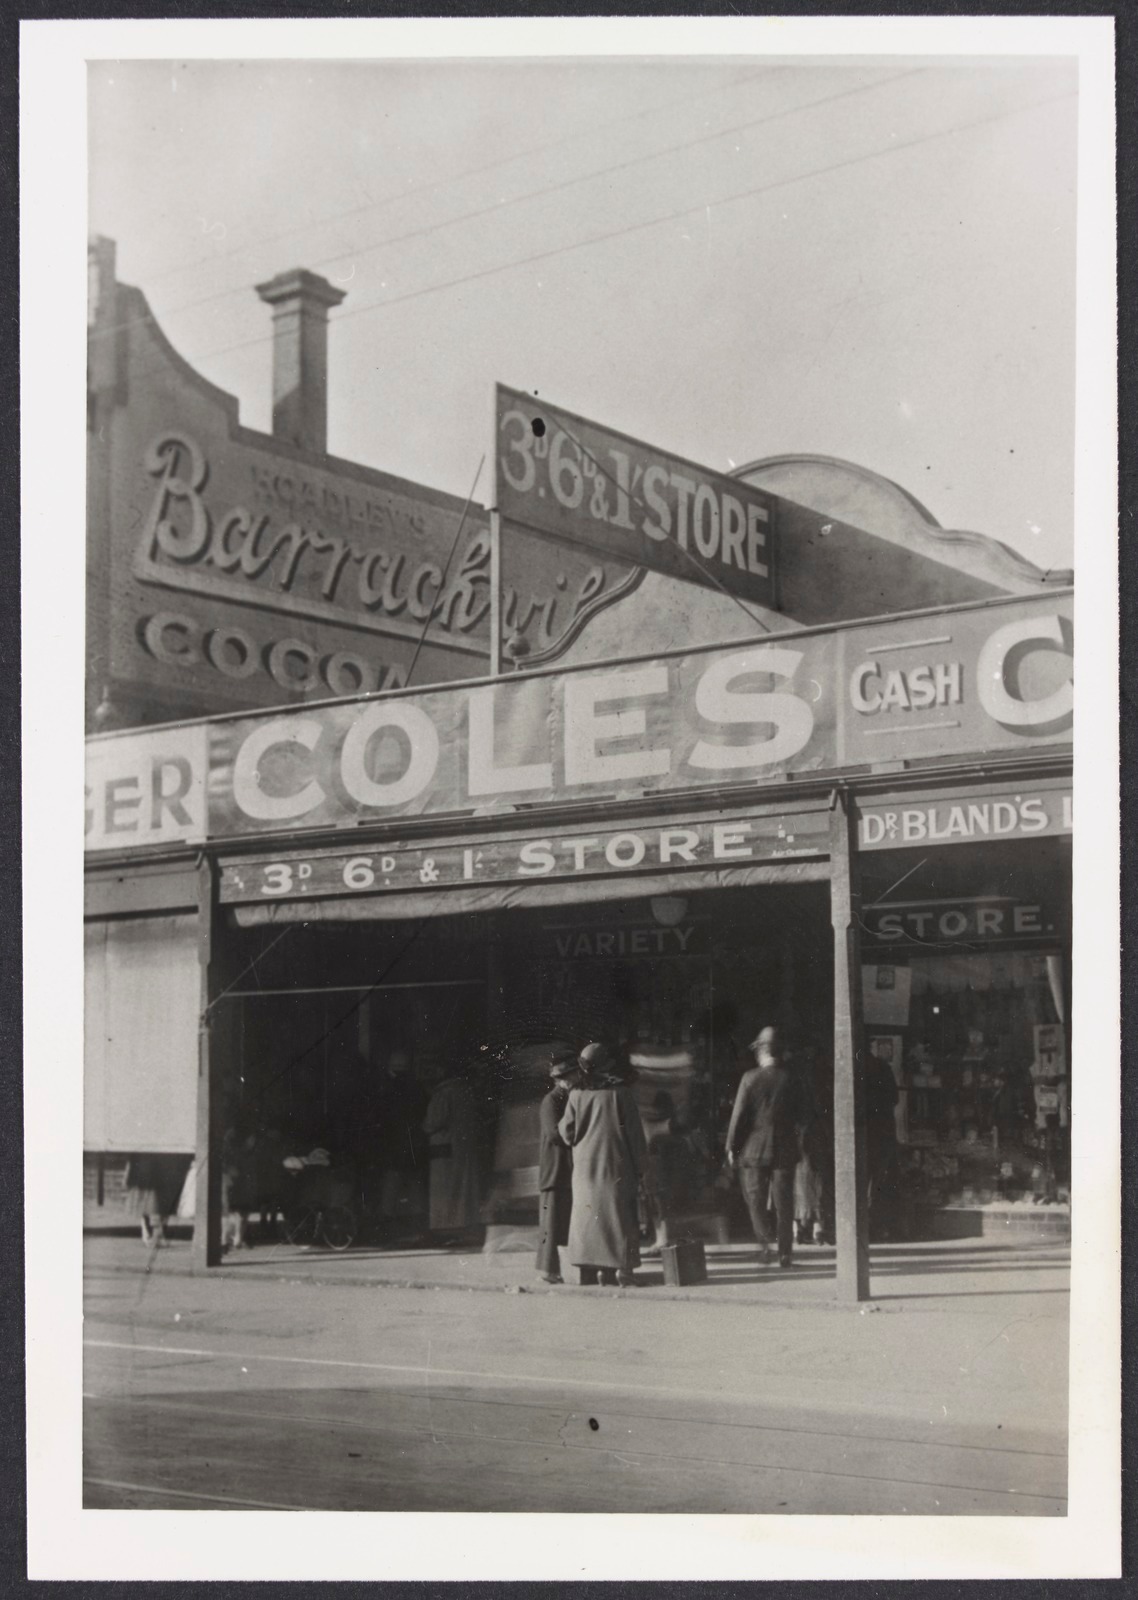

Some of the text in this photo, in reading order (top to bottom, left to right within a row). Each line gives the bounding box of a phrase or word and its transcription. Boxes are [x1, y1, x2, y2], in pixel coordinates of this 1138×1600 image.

[590, 473, 610, 521] &
[642, 465, 769, 578] STORE
[139, 611, 408, 697] COCOA
[850, 614, 1074, 729] CASH C
[233, 647, 815, 821] COLES
[419, 858, 440, 883] &
[516, 824, 753, 875] STORE
[902, 795, 1049, 842] BLAND'S
[554, 926, 696, 958] VARIETY
